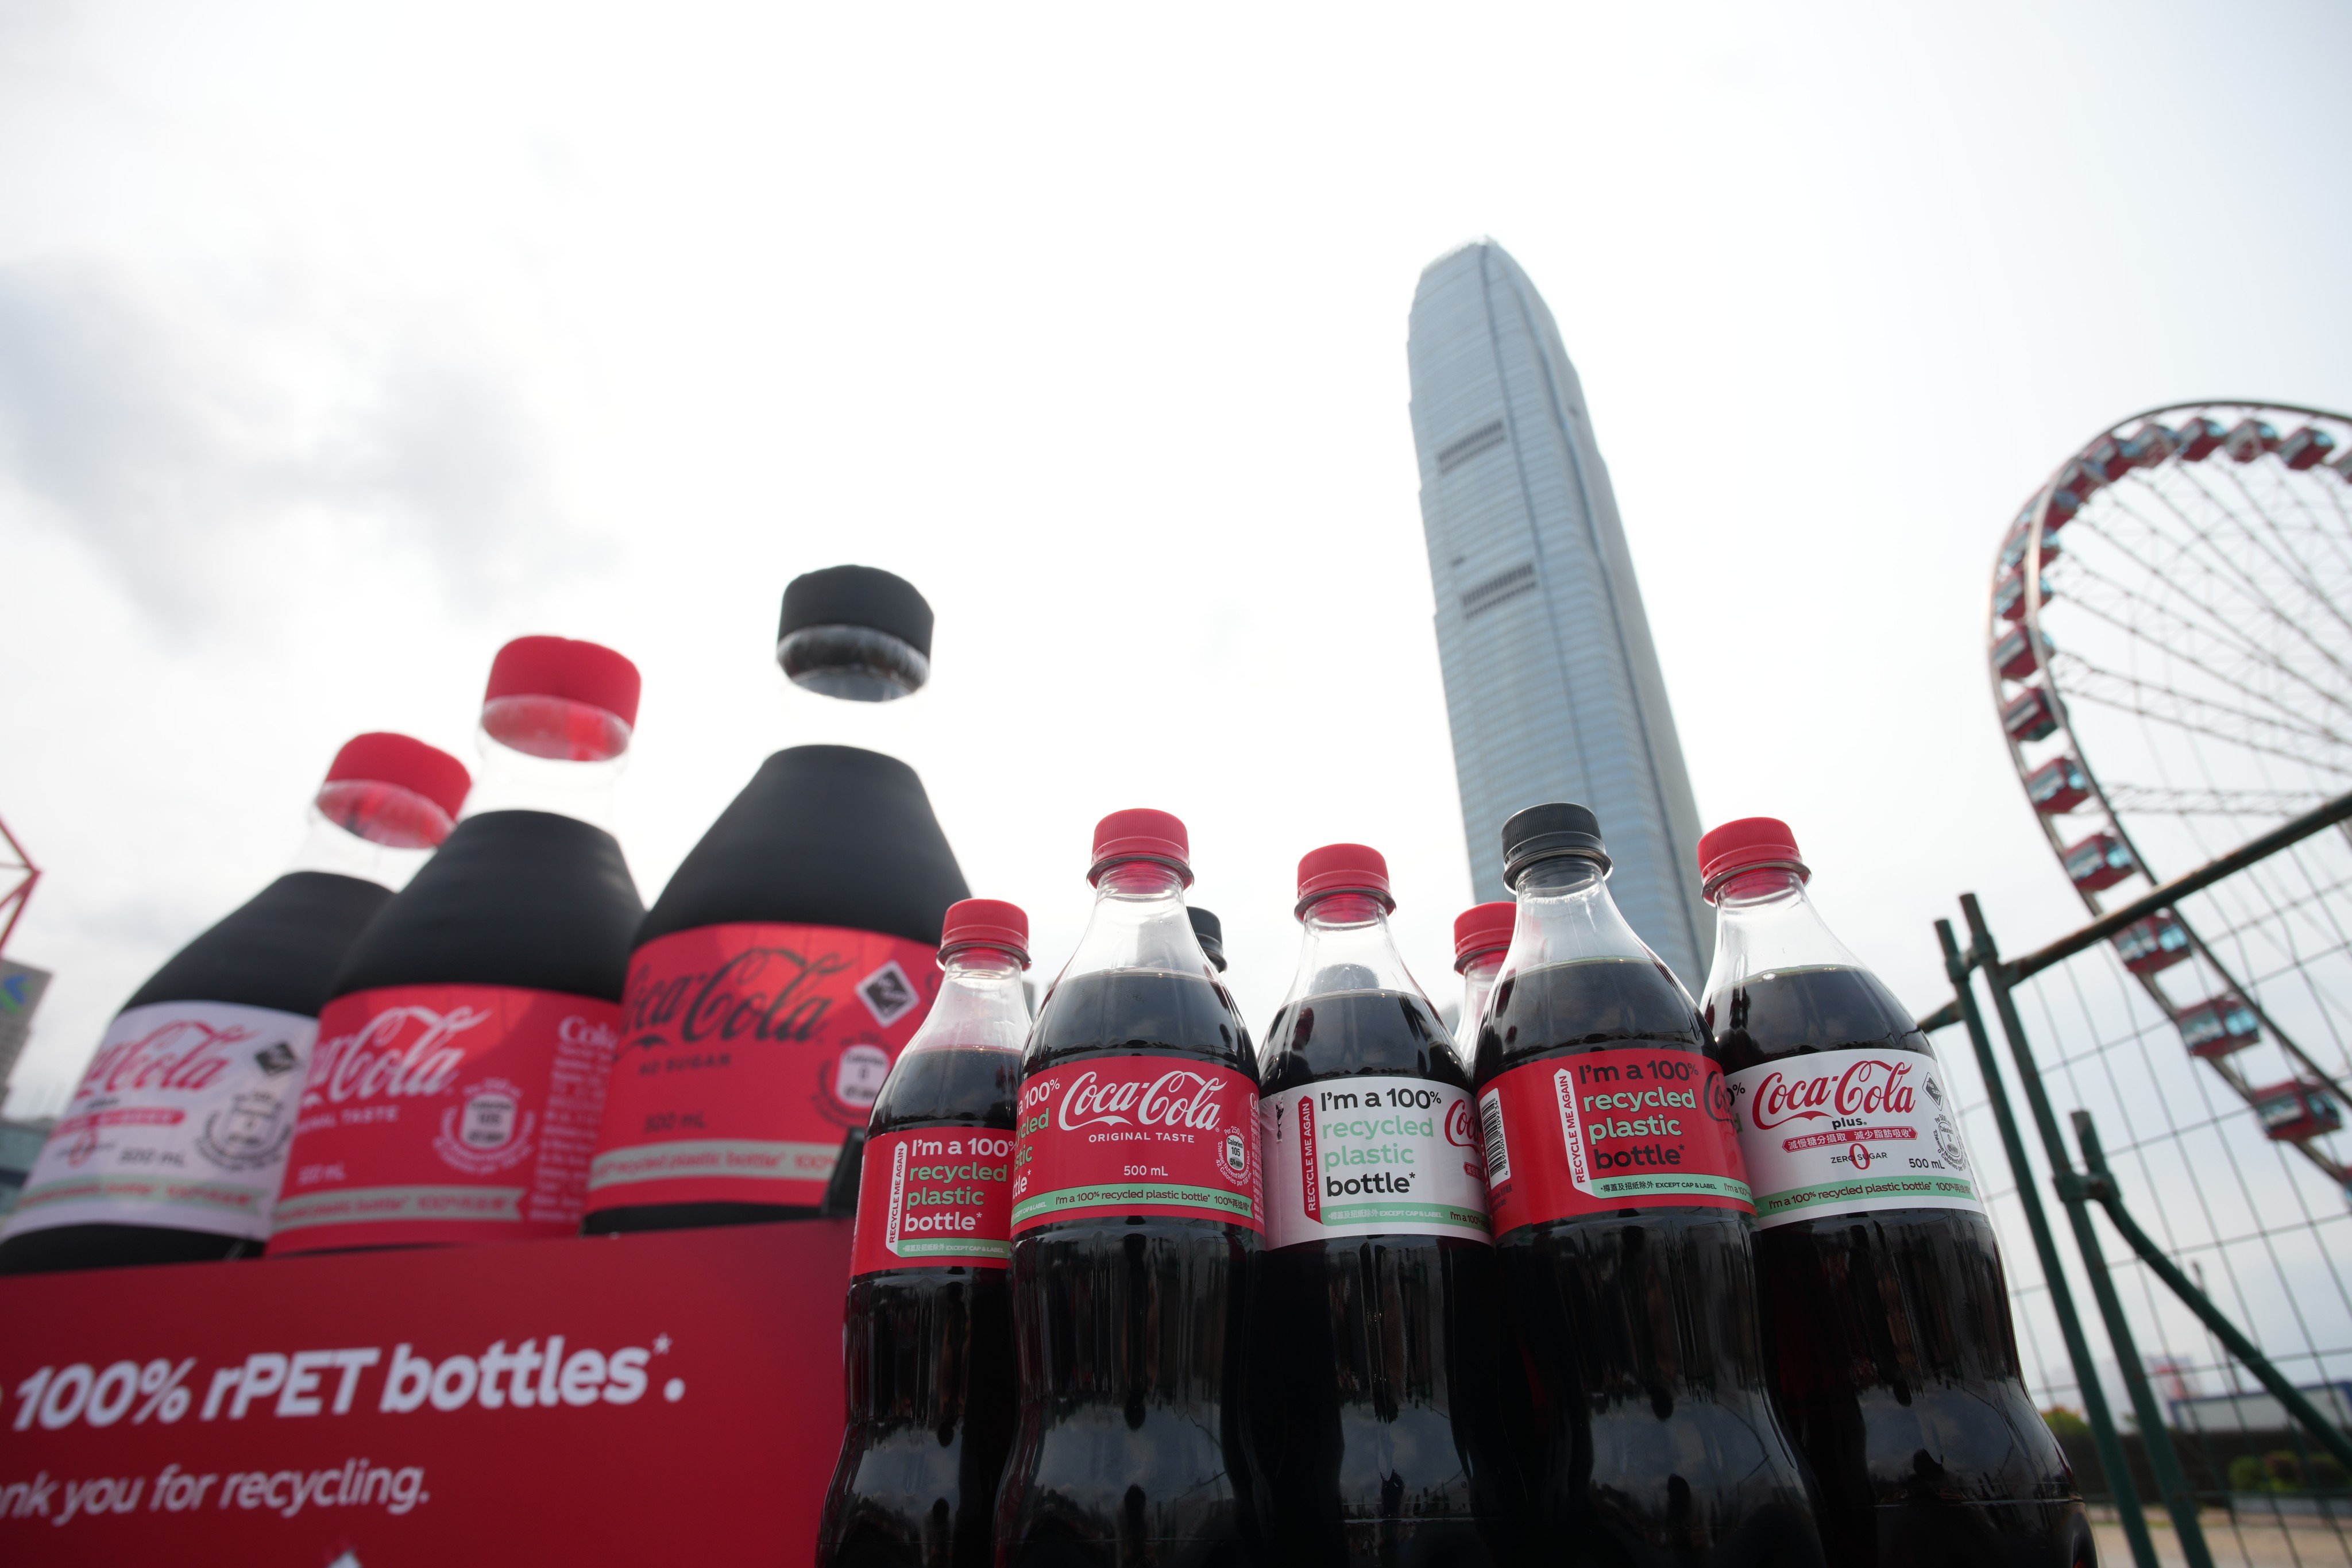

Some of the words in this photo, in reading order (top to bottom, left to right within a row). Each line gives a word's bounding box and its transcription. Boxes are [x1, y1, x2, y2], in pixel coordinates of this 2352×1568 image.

[623, 948, 858, 1060] oca-Cola
[306, 1005, 493, 1103] a-Cola
[1579, 1065, 1619, 1084] I'm
[1627, 1067, 1643, 1079] a
[1647, 1060, 1699, 1081] 100%
[1018, 1099, 1023, 1115] a
[1025, 1077, 1060, 1109] 100%
[1059, 1071, 1227, 1131] Coca-Cola
[1321, 1092, 1358, 1111] I'm
[1365, 1092, 1381, 1107] a
[1387, 1088, 1442, 1109] 100%
[1559, 1076, 1572, 1109] AGAIN
[1584, 1087, 1696, 1112] recycled
[1752, 1060, 1915, 1130] Coca-Cola
[1303, 1103, 1312, 1137] AGAIN
[1494, 1099, 1502, 1130] 109234
[1567, 1111, 1575, 1128] ME
[1832, 1117, 1863, 1130] plus
[1015, 1107, 1049, 1147] ycled
[1088, 1133, 1150, 1143] ORIGINAL
[1156, 1133, 1195, 1143] TASTE
[1231, 1126, 1239, 1135] 250
[1322, 1115, 1434, 1140] recycled
[1588, 1114, 1682, 1145] plastic
[1948, 1134, 1952, 1142] 0
[912, 1139, 942, 1157] I'm
[948, 1141, 961, 1154] a
[968, 1138, 1017, 1157] 100%
[1227, 1137, 1243, 1148] Calories
[1231, 1146, 1241, 1156] 105
[1306, 1139, 1312, 1157] ME
[1499, 1133, 1507, 1164] 890008
[1789, 1133, 1847, 1150] 減慢糖分攝取
[1014, 1144, 1033, 1171] stic
[1324, 1142, 1415, 1172] plastic
[1571, 1131, 1585, 1184] RECYCLE
[1830, 1155, 1855, 1164] ZERO
[1857, 1152, 1888, 1160] SUGAR
[1909, 1158, 1929, 1169] 500
[1932, 1158, 1945, 1169] mL
[1941, 1153, 1958, 1170] Calories
[909, 1161, 1007, 1183] recycled
[1124, 1165, 1146, 1176] 500
[1150, 1166, 1168, 1176] mL
[1220, 1167, 1236, 1184] Calories
[1223, 1163, 1238, 1179] Nutrient
[1013, 1169, 1032, 1199] ttle
[1307, 1158, 1316, 1211] RECYCLE
[1769, 1200, 1783, 1209] I'm
[1791, 1191, 1816, 1203] 100%
[1818, 1184, 1863, 1200] recycled
[1865, 1181, 1899, 1196] plastic
[906, 1186, 984, 1210] plastic
[1033, 1202, 1046, 1210] LABEL
[1056, 1196, 1068, 1205] I'm
[1077, 1191, 1100, 1202] 100%
[1102, 1189, 1144, 1202] recycled
[1146, 1190, 1179, 1201] plastic
[889, 1198, 899, 1243] RECYCLE
[894, 1179, 901, 1195] ME
[1450, 1211, 1461, 1221] I'm
[1467, 1215, 1481, 1224] 100%
[11, 1357, 197, 1431] 100%
[200, 1347, 382, 1420] rPET
[53, 1477, 144, 1527] you
[149, 1463, 218, 1513] for
[219, 1458, 431, 1519] recycling.
